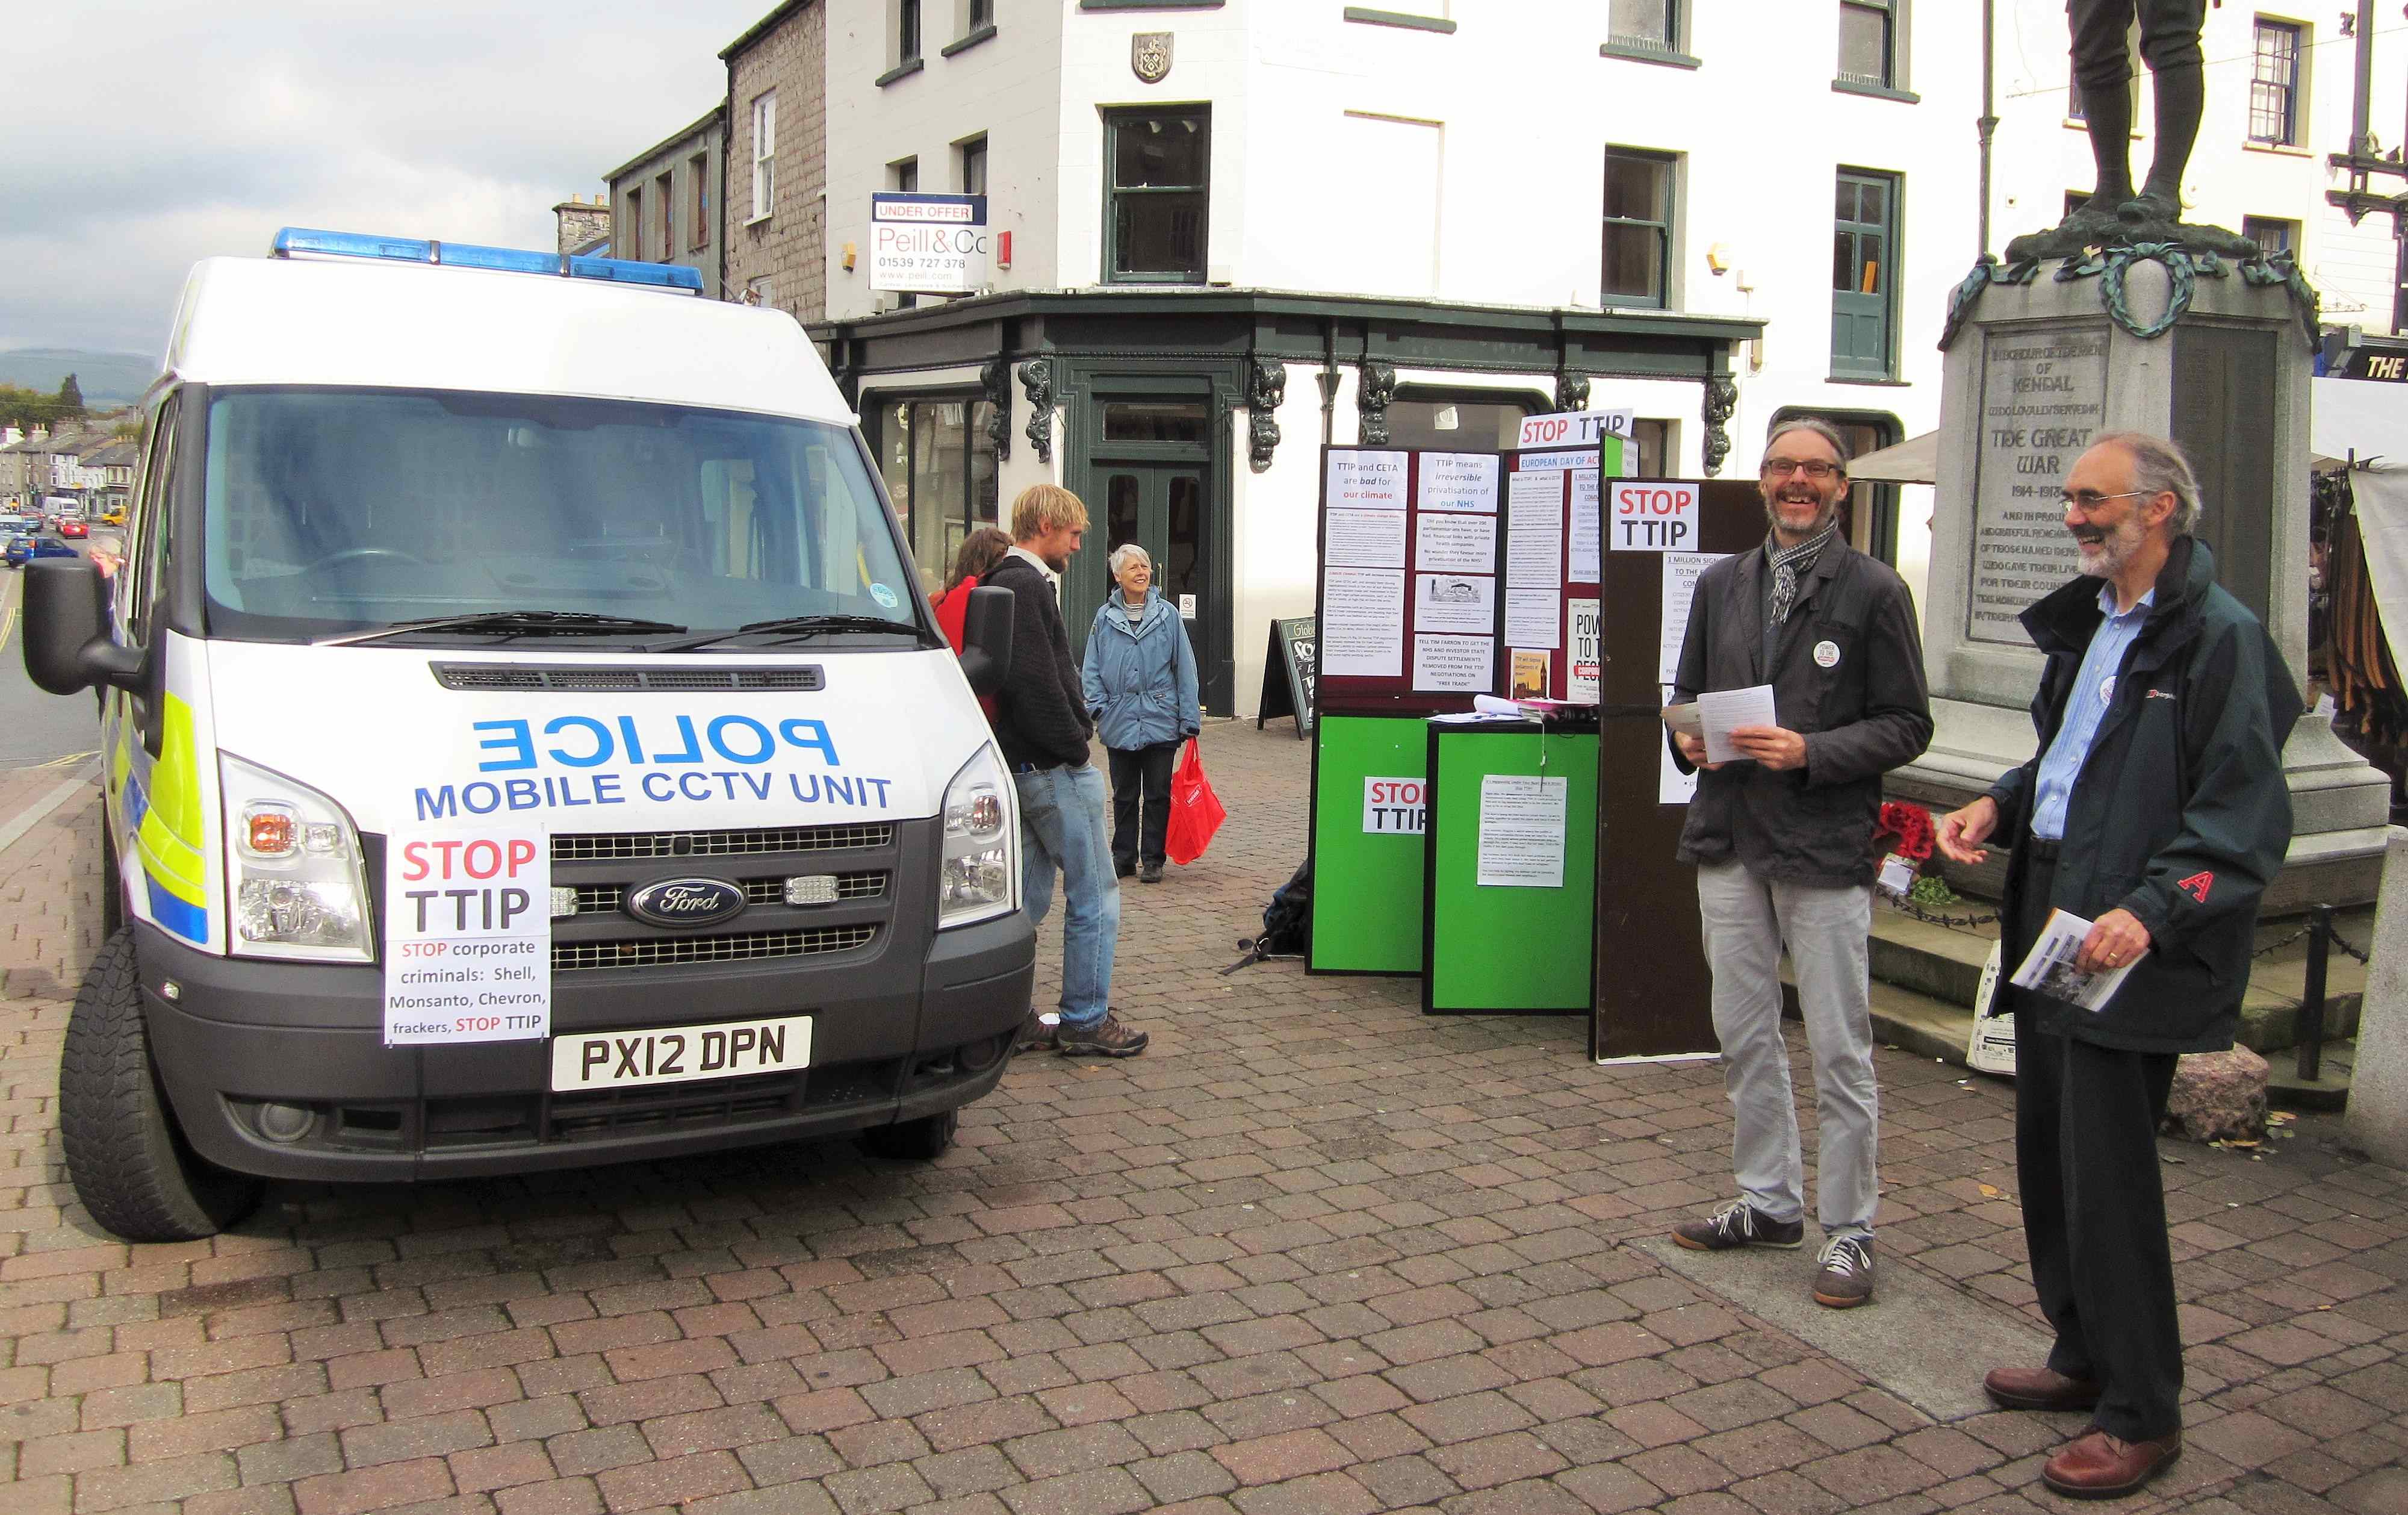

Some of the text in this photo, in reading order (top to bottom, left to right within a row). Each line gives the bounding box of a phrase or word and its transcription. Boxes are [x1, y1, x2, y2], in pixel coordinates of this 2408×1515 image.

[880, 205, 970, 219] UNDER OFFER
[879, 257, 966, 269] 01539 727 378
[2036, 362, 2052, 375] OF
[2367, 356, 2406, 379] THE
[2012, 375, 2075, 393] KENDAL
[1522, 414, 1625, 443] STOP TTIP
[2031, 428, 2093, 447] GREAT
[1337, 462, 1398, 472] TTIP and CETA
[1435, 459, 1453, 467] TTIP
[1521, 458, 1557, 468] EUROPEAN
[1560, 457, 1574, 466] DAY
[1575, 456, 1586, 465] OF
[2017, 456, 2060, 474] WAR
[1359, 476, 1377, 485] bad
[1378, 477, 1391, 487] for
[1361, 490, 1393, 500] climate
[1427, 486, 1489, 496] privatisation of
[1619, 489, 1692, 515] STOP
[1621, 520, 1687, 546] TTIP
[1577, 637, 1592, 658] TO
[414, 771, 892, 821] MOBILE CCTV UNIT
[403, 839, 536, 881] STOP
[2176, 871, 2214, 903] A
[659, 886, 720, 913] Ford
[405, 888, 530, 933] TTIP
[402, 941, 536, 959] STOP corporate
[400, 966, 536, 984] criminals: Shell,
[389, 992, 547, 1009] Monsanto, Chevron,
[393, 1015, 542, 1034] frackers, STOP TTIP
[582, 1024, 786, 1081] PX12 DPN
